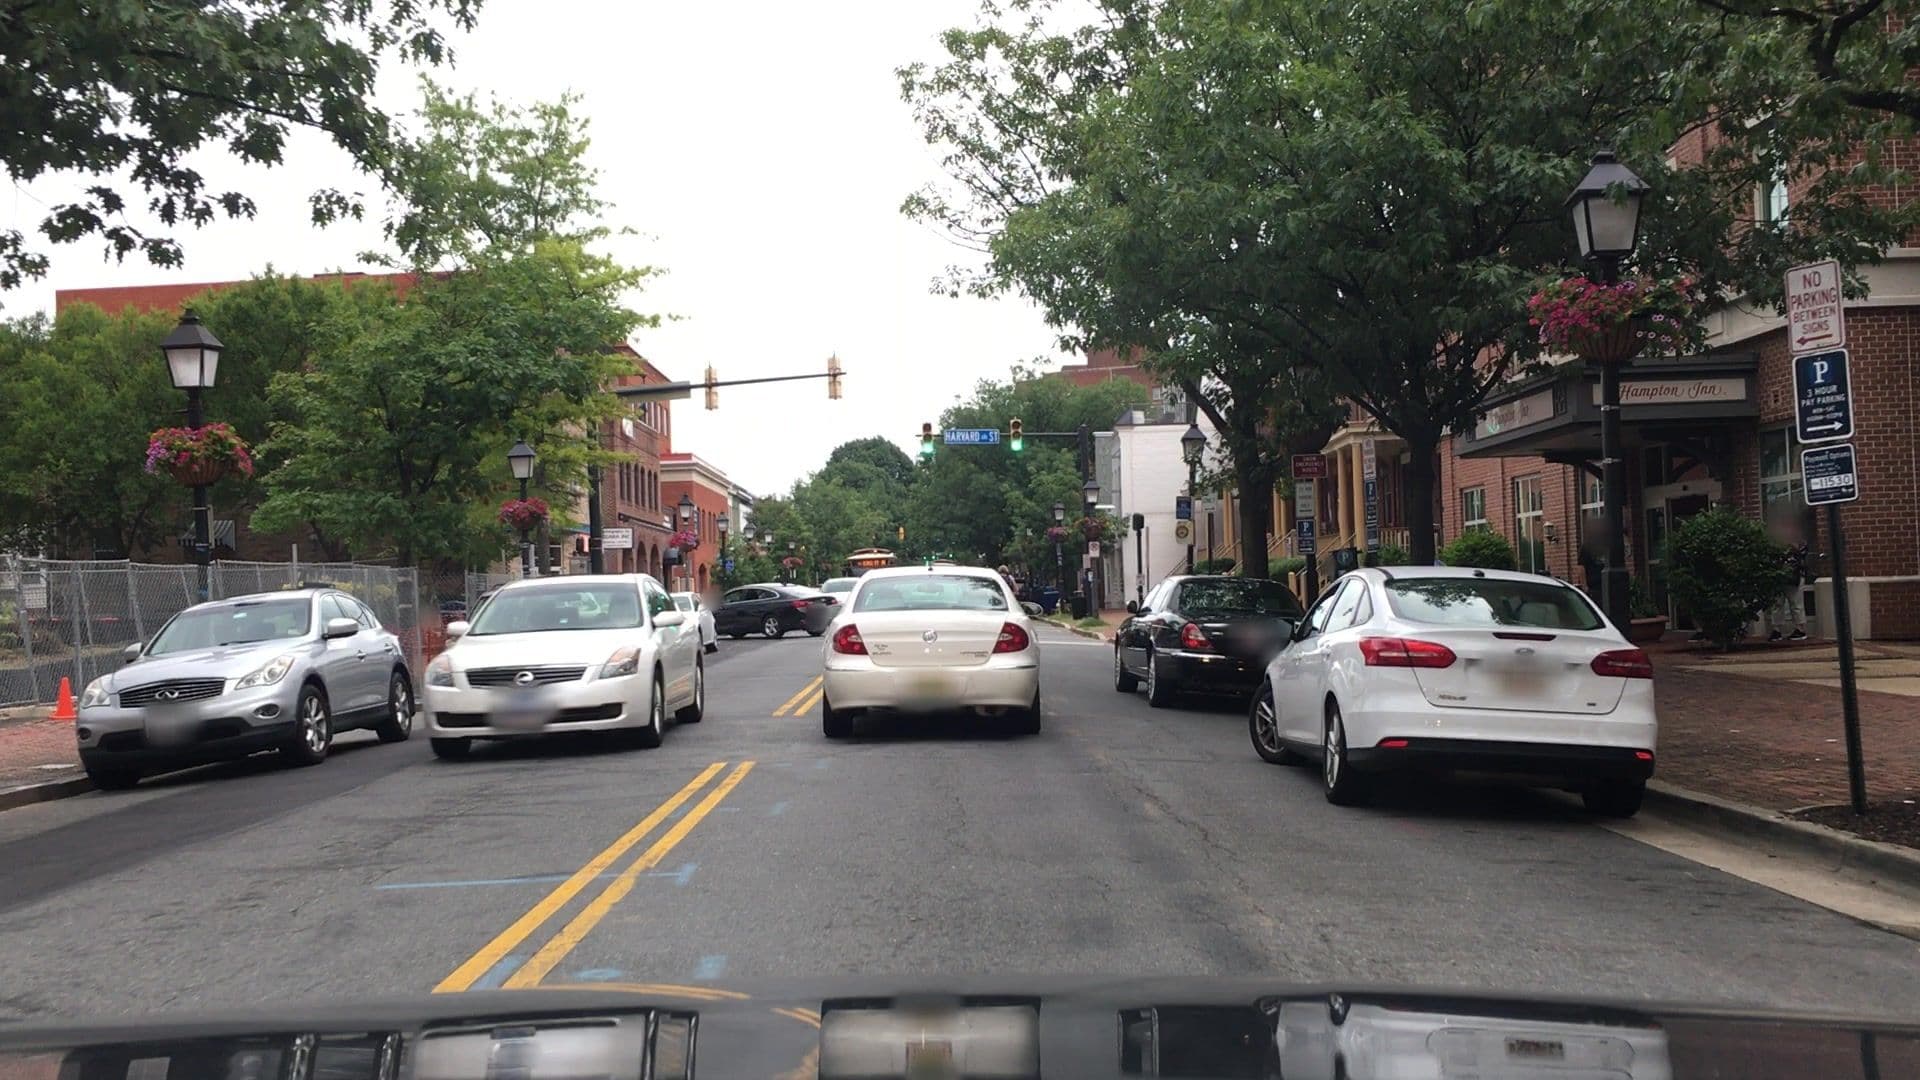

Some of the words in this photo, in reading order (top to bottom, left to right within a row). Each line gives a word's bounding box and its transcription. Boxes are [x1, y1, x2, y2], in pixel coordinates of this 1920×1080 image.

[1802, 271, 1821, 289] NO
[1791, 287, 1837, 310] PARKING
[1793, 306, 1836, 323] BETWEEN
[1802, 320, 1830, 335] SIGNS
[1813, 360, 1828, 384] P
[1619, 383, 1684, 400] Hampton
[1688, 382, 1723, 399] Inn
[1814, 384, 1838, 396] HOUR
[1801, 398, 1815, 408] PAY
[1816, 393, 1846, 405] PARKING
[945, 431, 980, 441] HARVARD
[989, 431, 998, 441] ST
